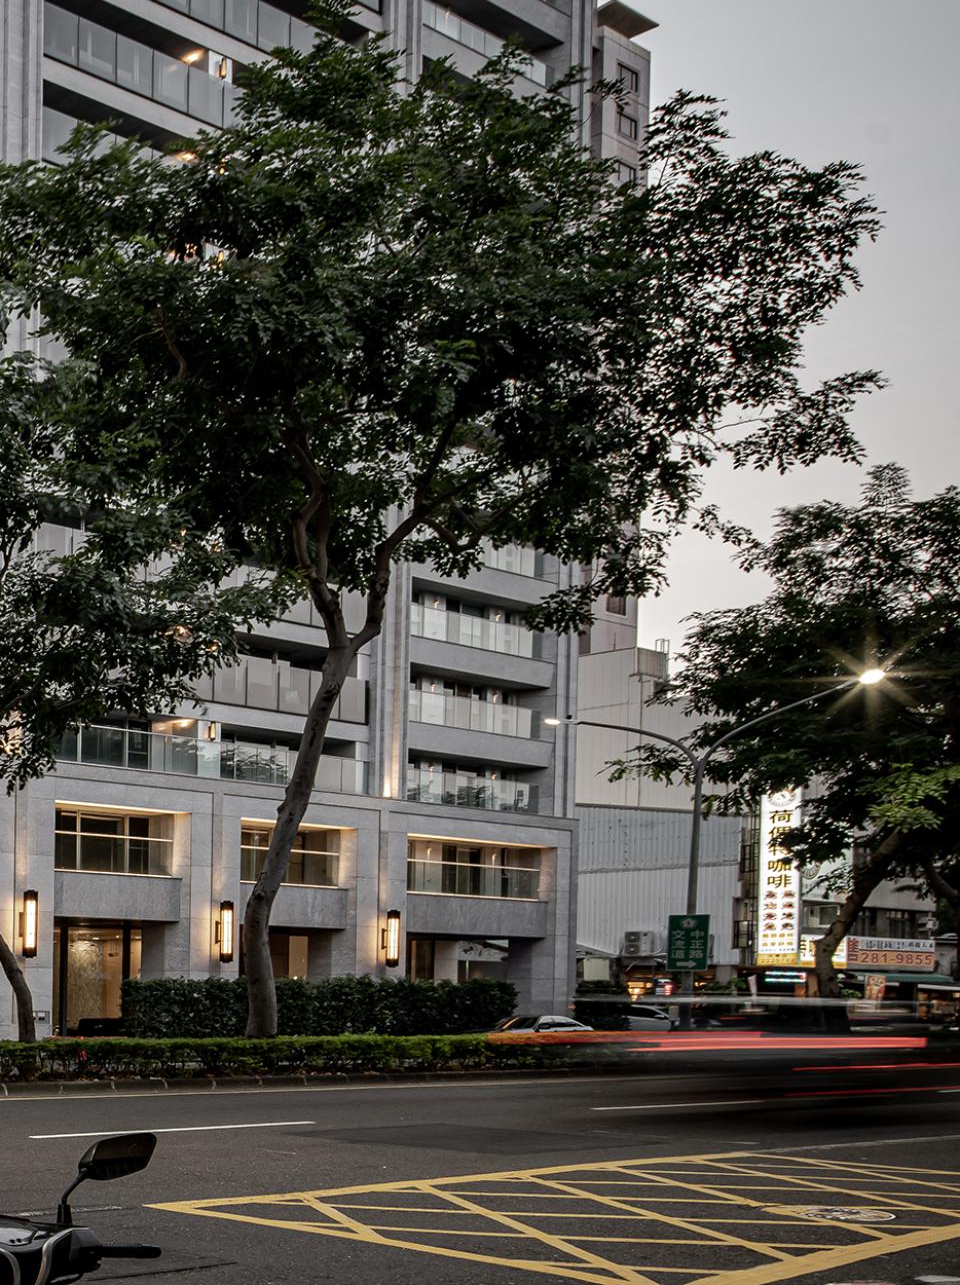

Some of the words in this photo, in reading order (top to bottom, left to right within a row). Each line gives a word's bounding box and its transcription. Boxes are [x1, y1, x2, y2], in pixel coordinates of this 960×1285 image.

[671, 930, 685, 958] 交流道
[689, 930, 704, 958] 中正路
[860, 952, 932, 965] 281-9855
